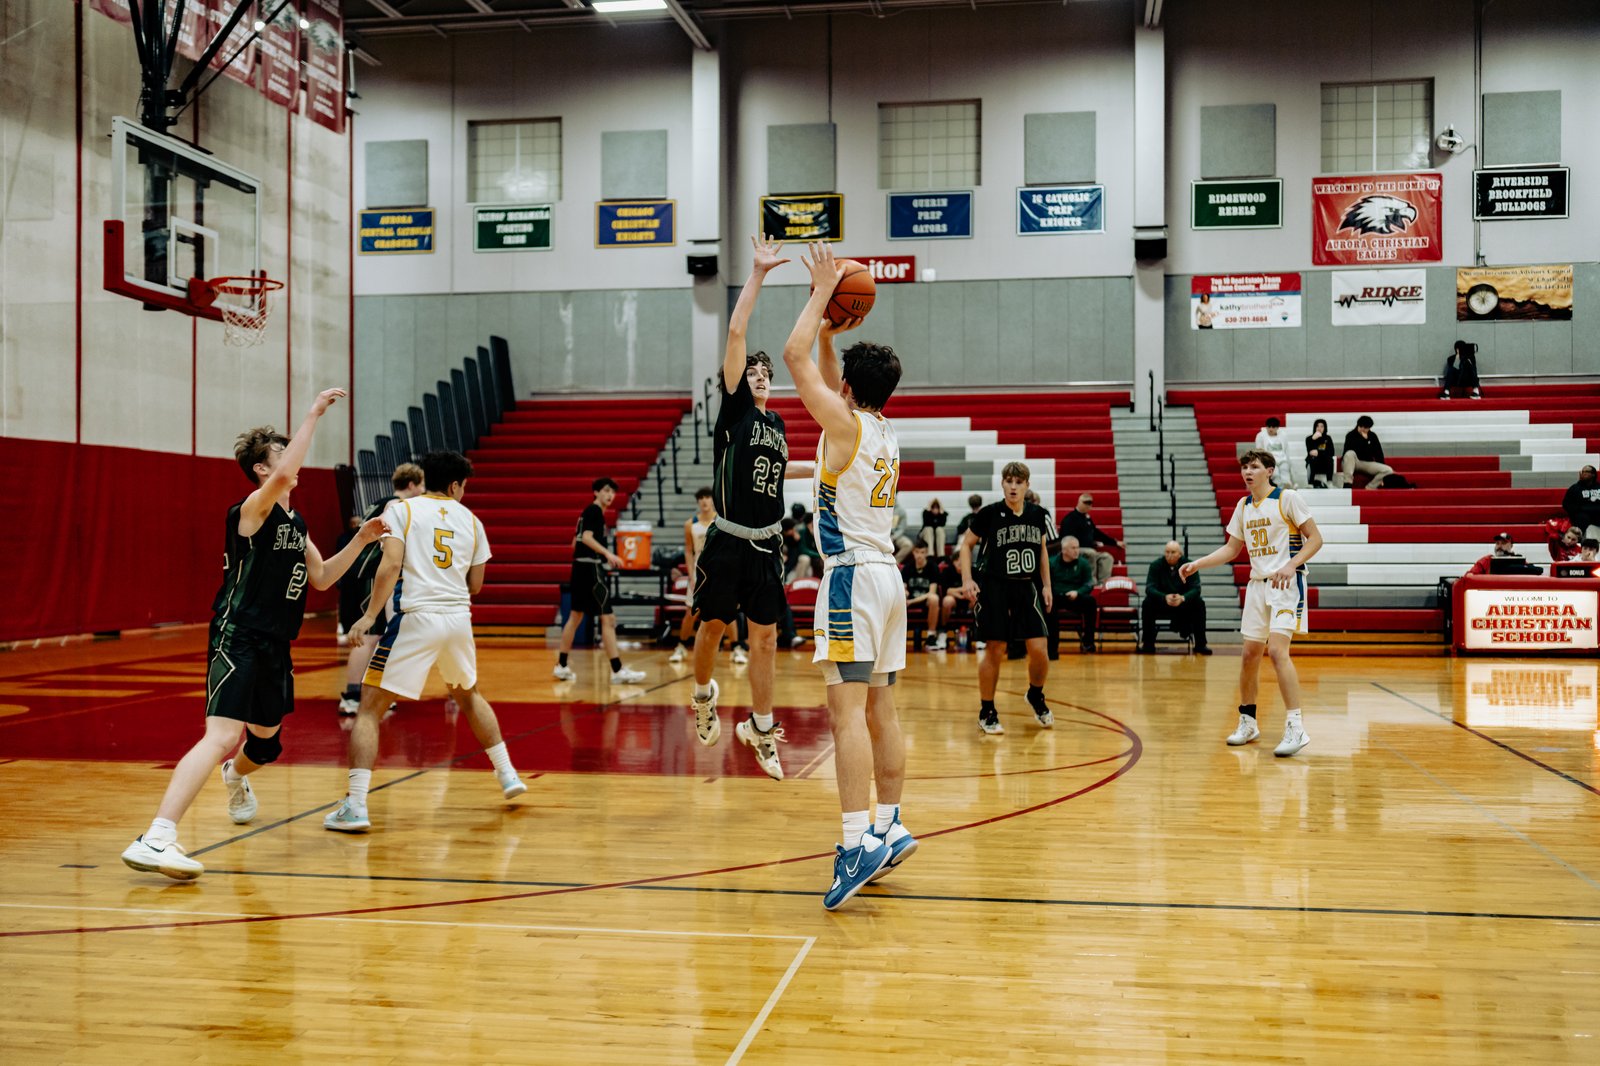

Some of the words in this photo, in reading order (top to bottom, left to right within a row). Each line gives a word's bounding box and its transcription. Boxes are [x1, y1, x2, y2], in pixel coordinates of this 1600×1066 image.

[1315, 183, 1359, 194] WELCOME
[1361, 182, 1374, 192] TO
[1376, 181, 1396, 192] THE
[1398, 181, 1425, 191] HOME
[1428, 180, 1440, 190] OF
[1492, 176, 1549, 188] RIVERSIDE
[1045, 192, 1090, 203] CATHOLIC
[1208, 193, 1267, 204] RIDGEWOOD
[1488, 188, 1553, 201] BROOKFIELD
[1048, 205, 1074, 216] PREP
[1218, 205, 1257, 216] REBELS
[1492, 201, 1546, 213] BULLDOGS
[1040, 216, 1082, 227] KNIGHTS
[912, 223, 948, 234] GATORS
[1326, 239, 1368, 251] AURORA
[1371, 237, 1429, 249] CHRISTIAN
[1357, 249, 1397, 260] EAGLES
[869, 259, 911, 279] itor
[1360, 286, 1422, 298] RIDGE
[753, 455, 782, 497] 23
[870, 458, 898, 508] 21
[1250, 528, 1268, 548] 30
[433, 528, 454, 569] 5
[1006, 548, 1036, 575] 20
[286, 562, 308, 600] 2
[1486, 604, 1577, 616] AURORA
[1471, 618, 1592, 630] CHRISTIAN
[1491, 631, 1572, 643] SCHOOL
